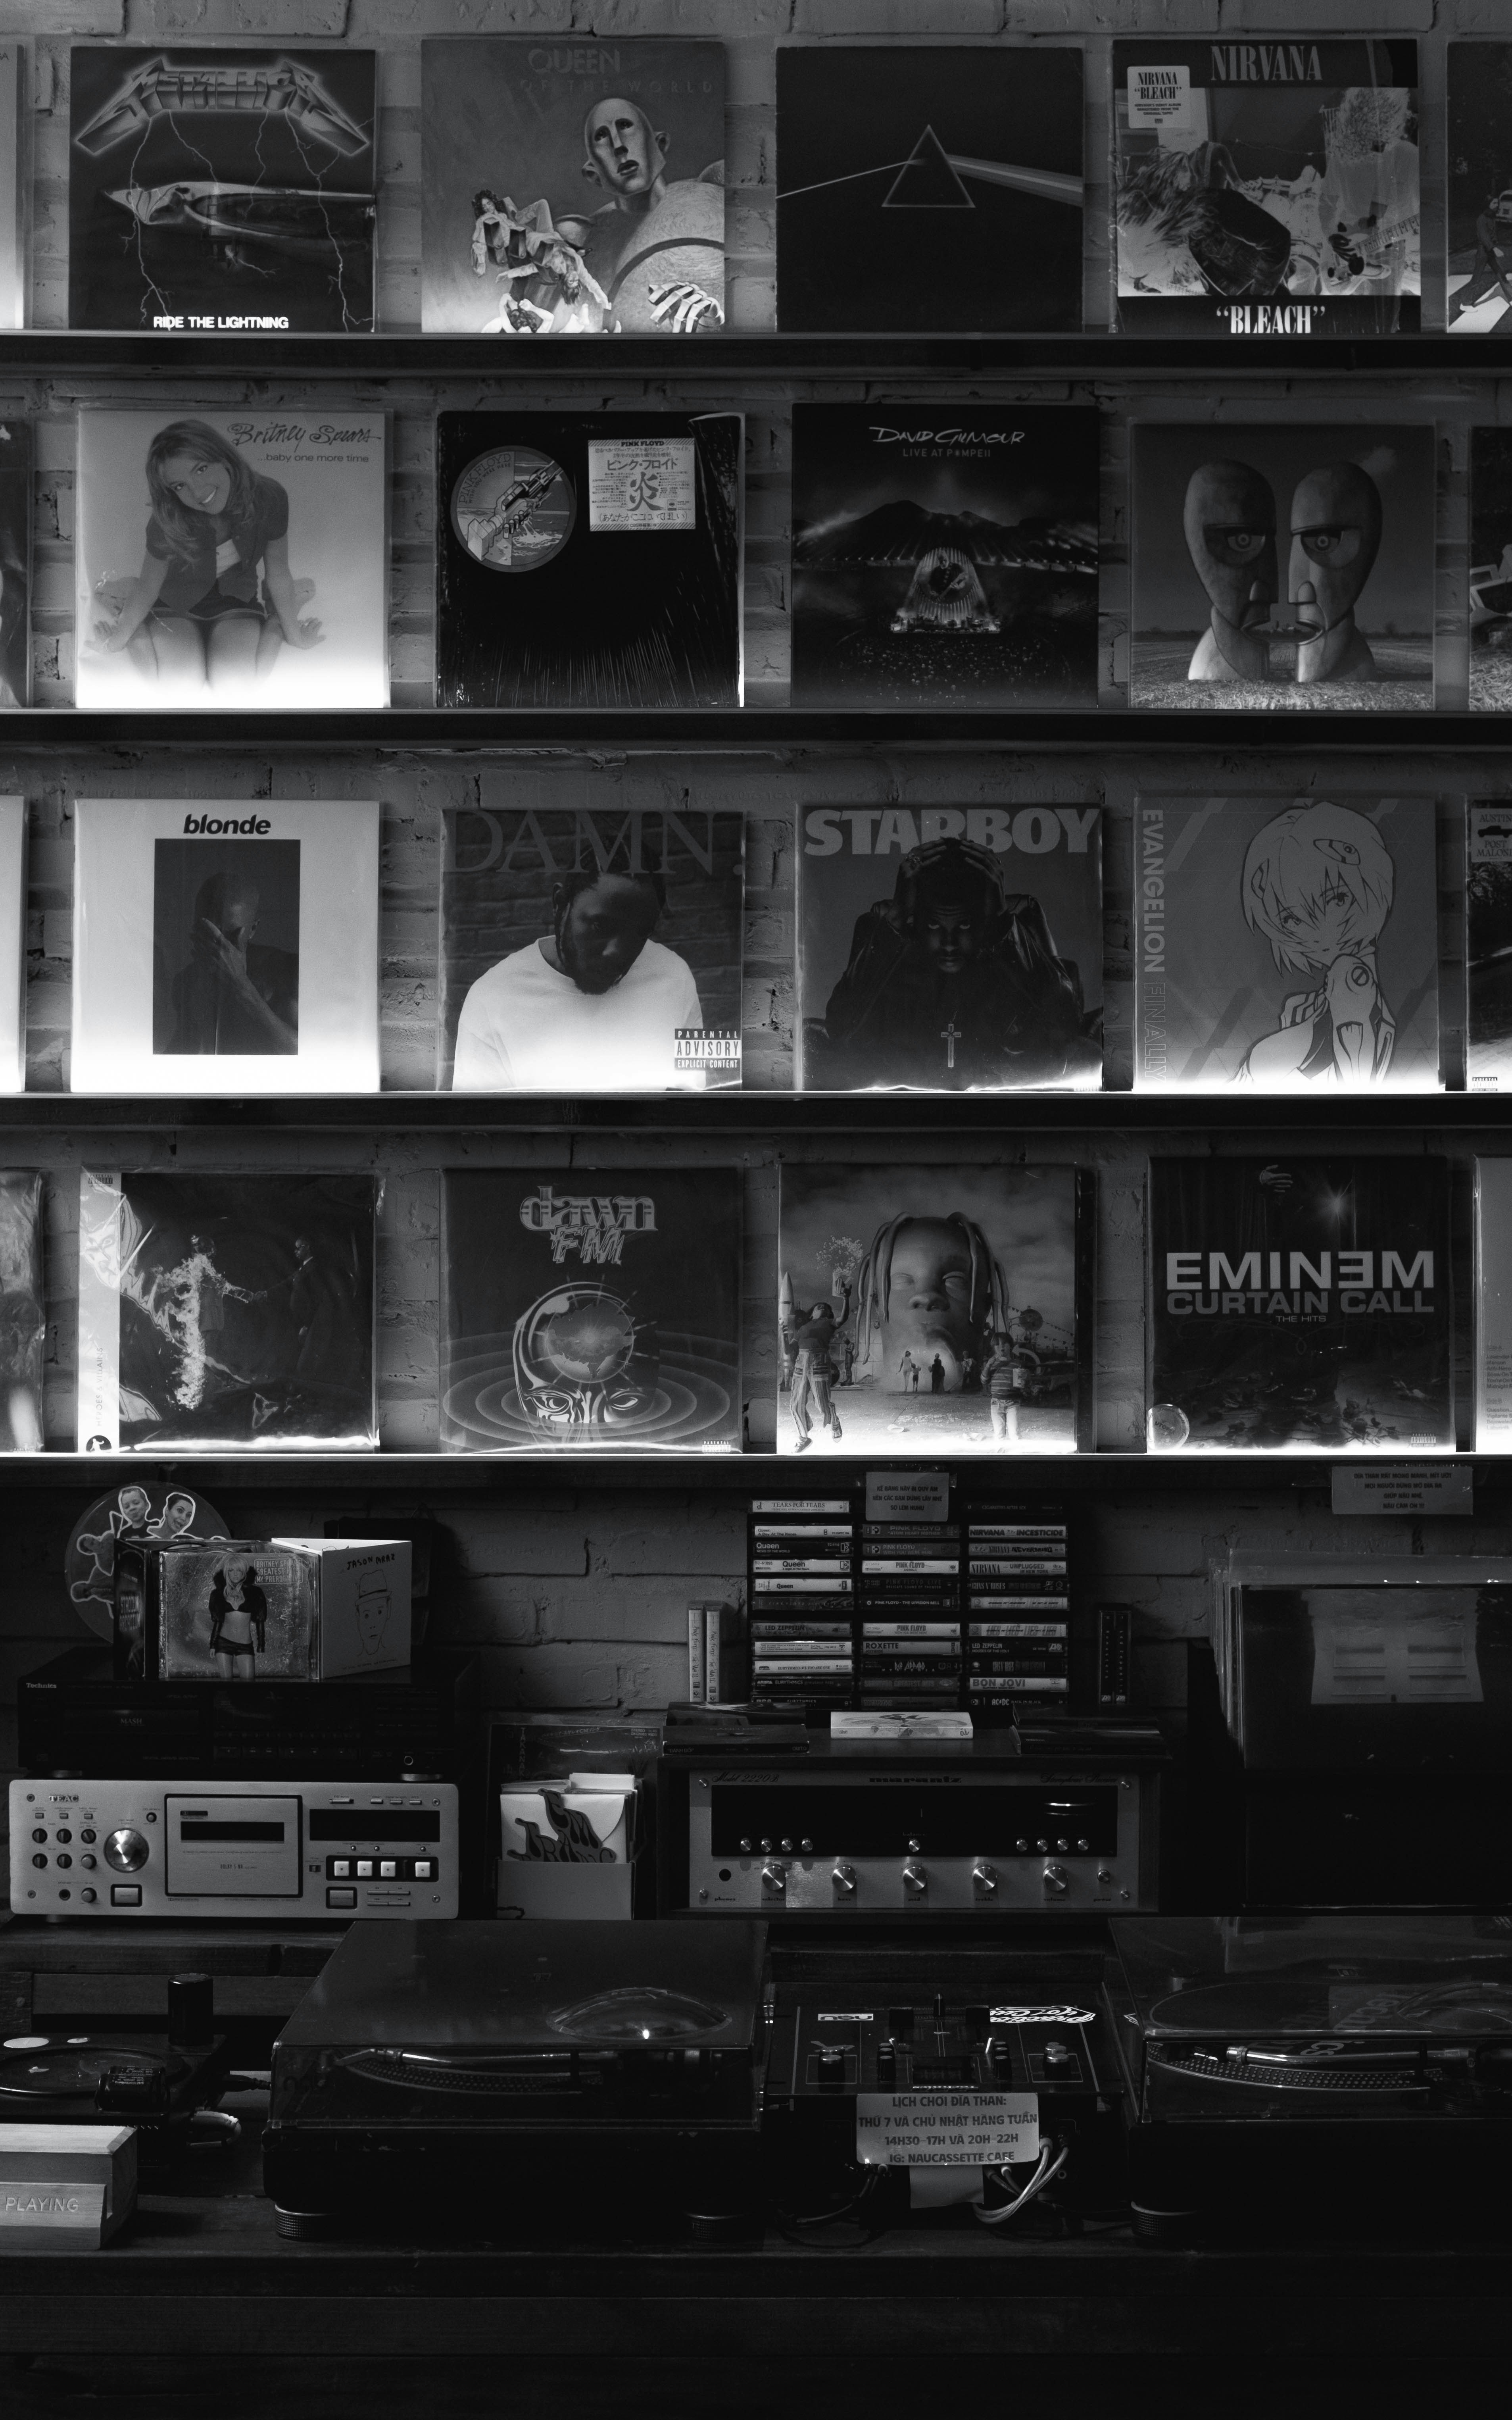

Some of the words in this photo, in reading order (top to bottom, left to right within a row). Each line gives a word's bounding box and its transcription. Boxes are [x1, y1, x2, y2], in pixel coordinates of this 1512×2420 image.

[528, 48, 620, 74] QUEEN
[1210, 46, 1322, 81] NIRVANA
[628, 81, 712, 93] WORLD
[1138, 72, 1177, 85] NIRVANA
[75, 59, 369, 156] METALLICA
[154, 316, 184, 328] RIDE
[188, 316, 215, 328] THE
[218, 316, 289, 328] LIGHTNING
[227, 422, 306, 452] Britney
[309, 425, 381, 445] Spears
[869, 427, 933, 442] DAVID
[935, 429, 1025, 446] GILMOUR
[903, 448, 927, 457] LIVE
[931, 448, 943, 457] AT
[459, 473, 478, 504] PINK
[474, 453, 511, 476] FLOYD
[626, 471, 664, 512] 炎
[183, 814, 271, 834] blonde
[804, 808, 1099, 856] STARBOY
[443, 810, 743, 875] DAMN.
[1143, 810, 1164, 972] EVANGELION
[677, 1041, 738, 1056] ADVISORY
[519, 1186, 658, 1231] dawn
[549, 1223, 626, 1266] FM
[1167, 1291, 1329, 1314] CURTAIN
[1340, 1290, 1434, 1314] CALL
[347, 1556, 373, 1570] JASON
[971, 1564, 1000, 1574] NIRVANA
[892, 2097, 916, 2108] LỊCH
[920, 2096, 947, 2106] CHƠI
[951, 2095, 970, 2106] ĐĨA
[973, 2096, 1006, 2106] THAN:
[859, 2115, 881, 2127] THỨ
[884, 2117, 891, 2127] 7
[894, 2115, 909, 2127] VÀ
[913, 2114, 936, 2127] CHỦ
[939, 2114, 968, 2128] NHẬT
[972, 2114, 1005, 2126] HÀNG
[949, 2133, 964, 2145] VÀ
[890, 2155, 905, 2163] IG:
[908, 2151, 1014, 2163] NAUCASSETTE.CAFE
[6, 2197, 79, 2212] PLAYING
